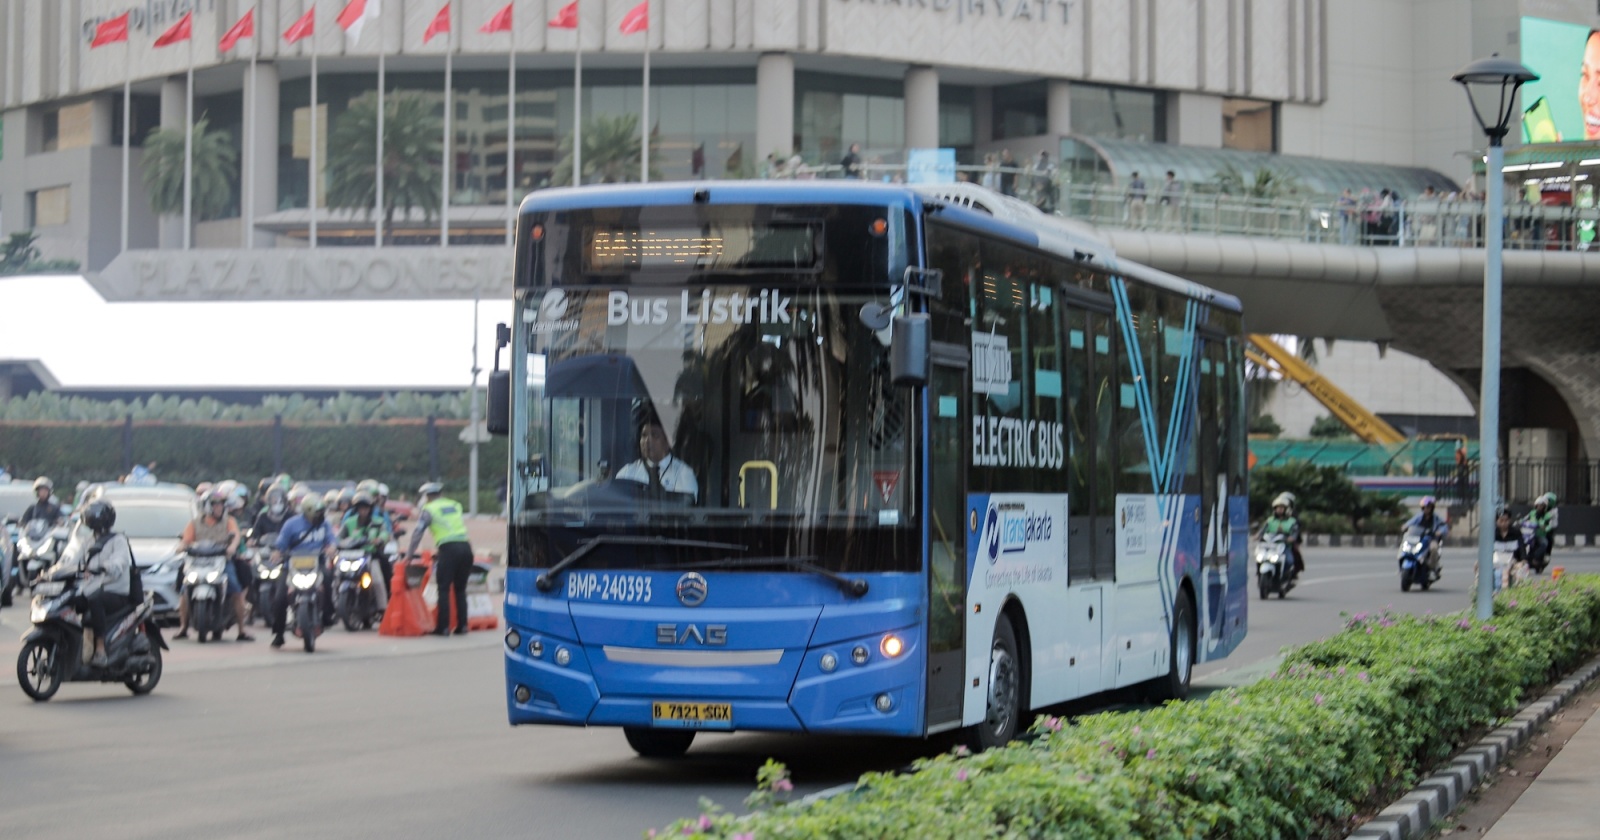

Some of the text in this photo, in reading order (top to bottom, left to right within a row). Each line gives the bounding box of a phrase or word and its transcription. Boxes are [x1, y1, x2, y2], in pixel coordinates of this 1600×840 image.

[133, 258, 271, 296] PLAZA
[608, 289, 791, 326] Bus Listrik
[972, 415, 1063, 470] ELECTRIC BUS
[1003, 508, 1052, 550] transjakarta
[567, 572, 652, 603] BMP-240393
[657, 623, 728, 645] SAG
[654, 703, 662, 719] B
